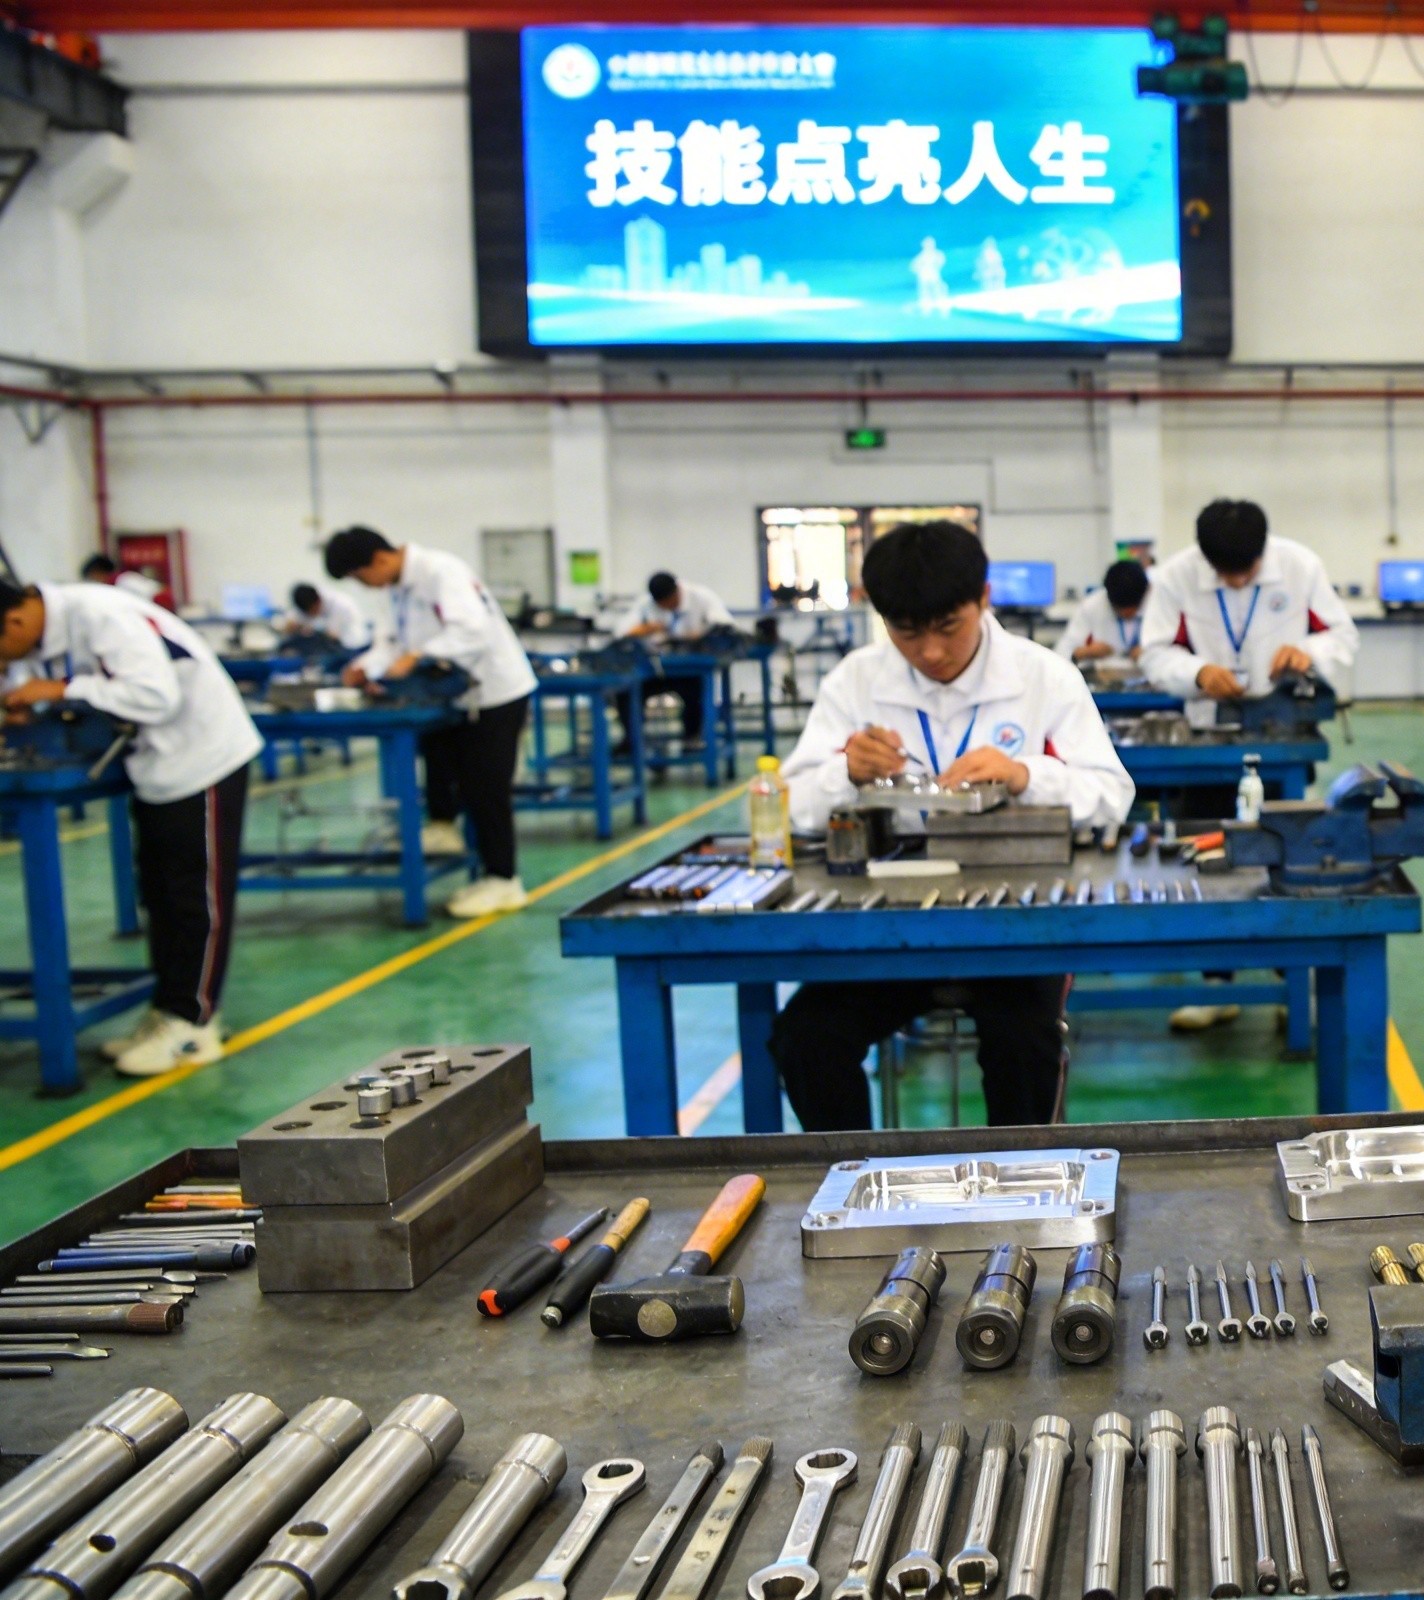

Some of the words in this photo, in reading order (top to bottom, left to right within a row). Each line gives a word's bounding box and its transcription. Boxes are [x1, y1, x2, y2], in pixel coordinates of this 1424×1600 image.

[585, 119, 1115, 206] 技能点亮人生
